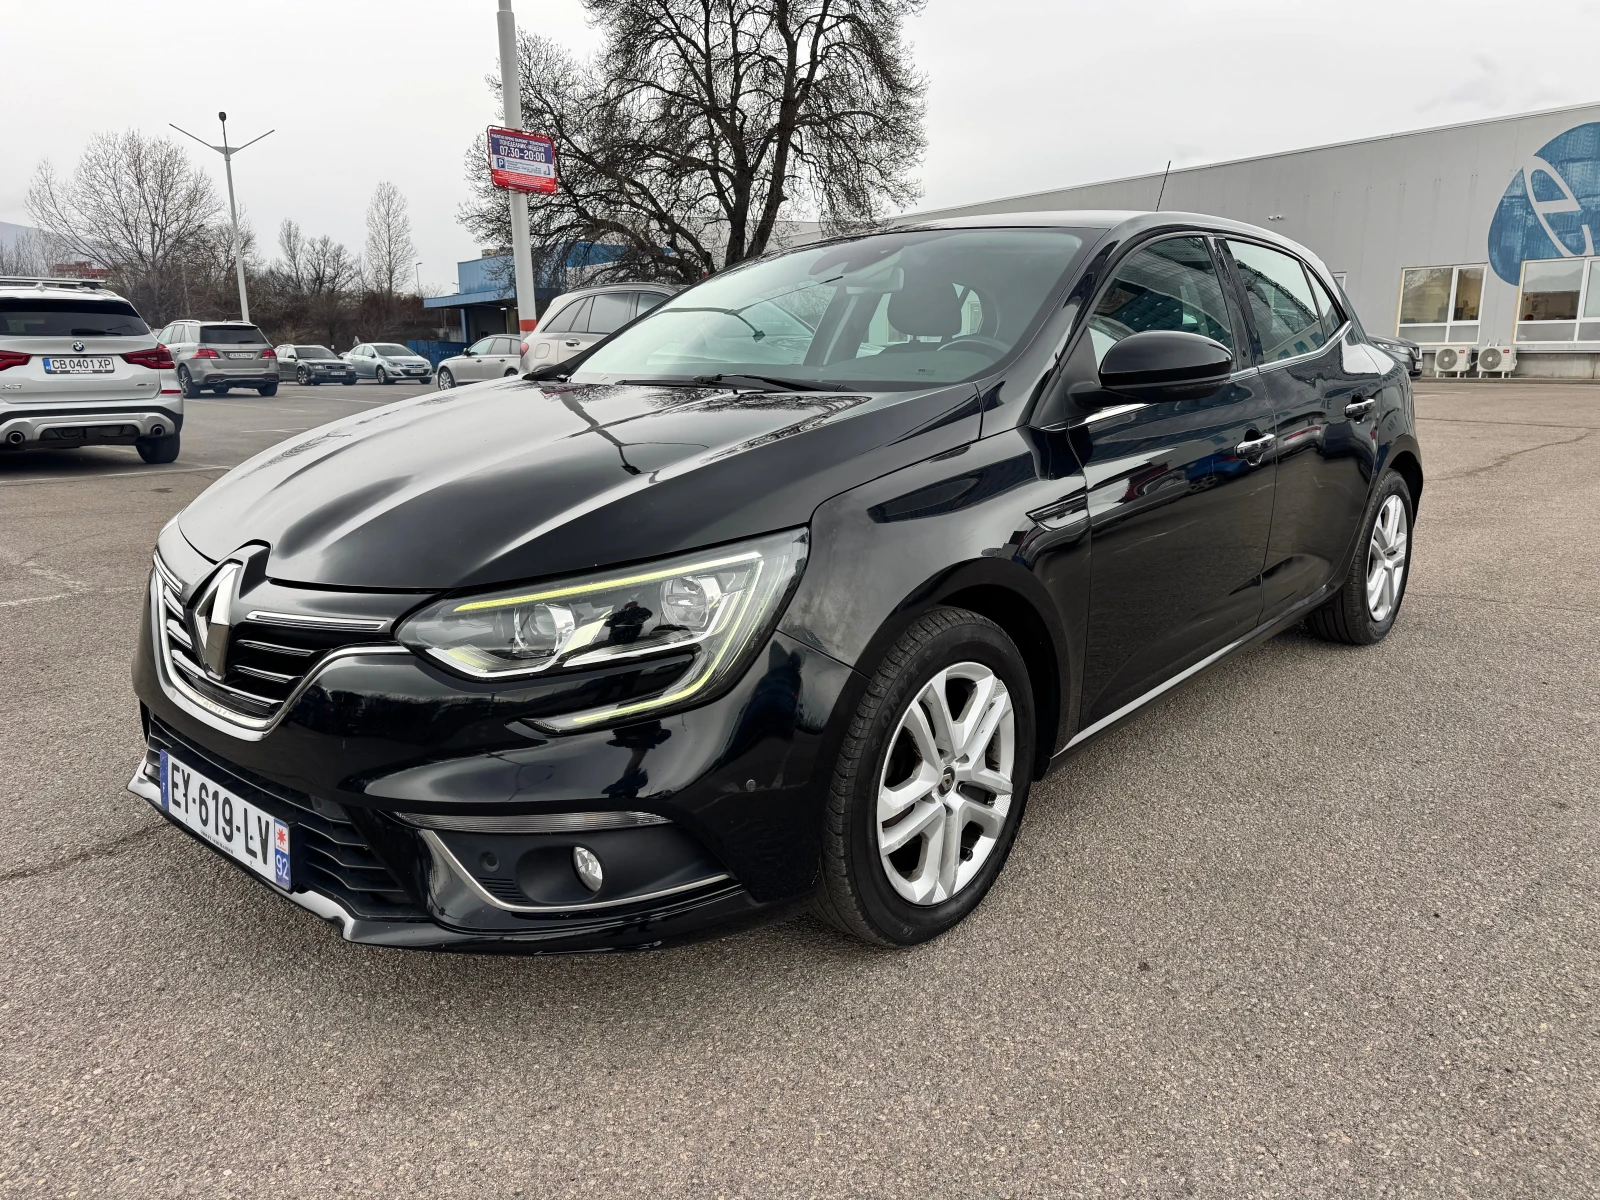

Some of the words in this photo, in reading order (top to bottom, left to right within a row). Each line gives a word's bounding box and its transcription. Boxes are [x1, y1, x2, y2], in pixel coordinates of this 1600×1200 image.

[69, 359, 95, 369] 0401
[171, 762, 270, 865] EY-619-LV
[276, 854, 289, 880] 92
